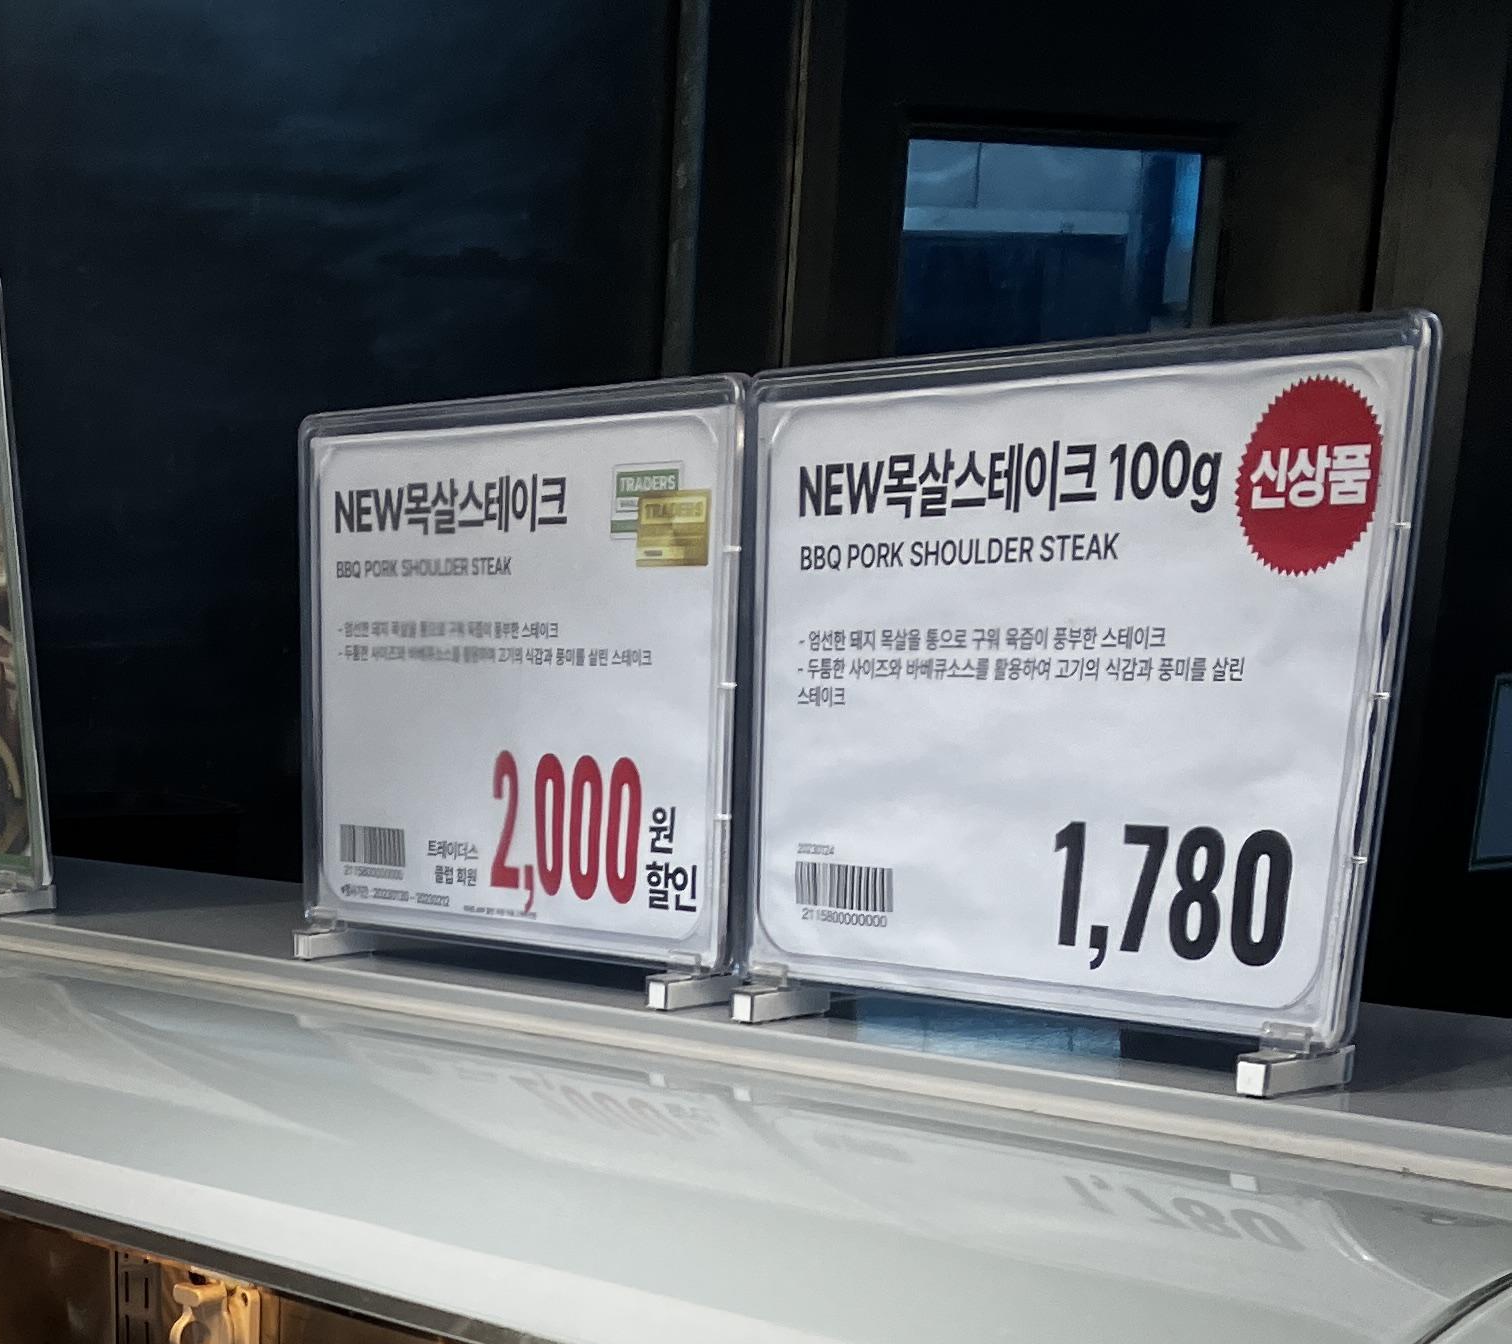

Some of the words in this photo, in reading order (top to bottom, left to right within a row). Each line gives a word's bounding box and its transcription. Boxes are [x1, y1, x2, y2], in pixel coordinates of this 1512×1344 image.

[619, 475, 676, 492] TRADERS
[798, 440, 1098, 519] NEW목살스테이크
[1110, 439, 1223, 514] 100g
[1250, 444, 1373, 511] 신상품
[335, 473, 567, 535] NEW목살스테이크
[337, 561, 361, 578] BBQ
[365, 559, 398, 578] PORK
[401, 557, 469, 577] SHOULDER
[472, 556, 512, 576] STEAK
[800, 545, 841, 572] BBQ
[848, 541, 903, 569] PORK
[910, 535, 1033, 567] SHOULDER
[1039, 532, 1120, 563] STEAK
[521, 621, 559, 639] 스테이크
[808, 630, 846, 651] 엄선한
[850, 629, 876, 650] 돼지
[881, 629, 921, 651] 목살을
[926, 628, 967, 650] 통으로
[972, 628, 1000, 651] 구워
[1005, 627, 1048, 650] 육즙이
[1053, 627, 1097, 650] 풍부한
[1101, 625, 1166, 650] 스테이크
[525, 647, 553, 666] 식감과
[611, 649, 652, 667] 스테이크
[808, 657, 845, 680] 두툼한
[849, 657, 902, 680] 사이즈와
[994, 657, 1051, 681] 활용하여
[1055, 657, 1100, 681] 고기의
[1105, 657, 1152, 681] 식감과
[1158, 657, 1206, 682] 풍미를
[1212, 656, 1245, 682] 살린
[798, 685, 845, 708] 스테이크
[490, 750, 643, 913] 2,000
[649, 806, 676, 854] 원
[427, 840, 479, 860] 트레이더스
[646, 861, 697, 912] 할인
[1055, 821, 1293, 970] 1,780
